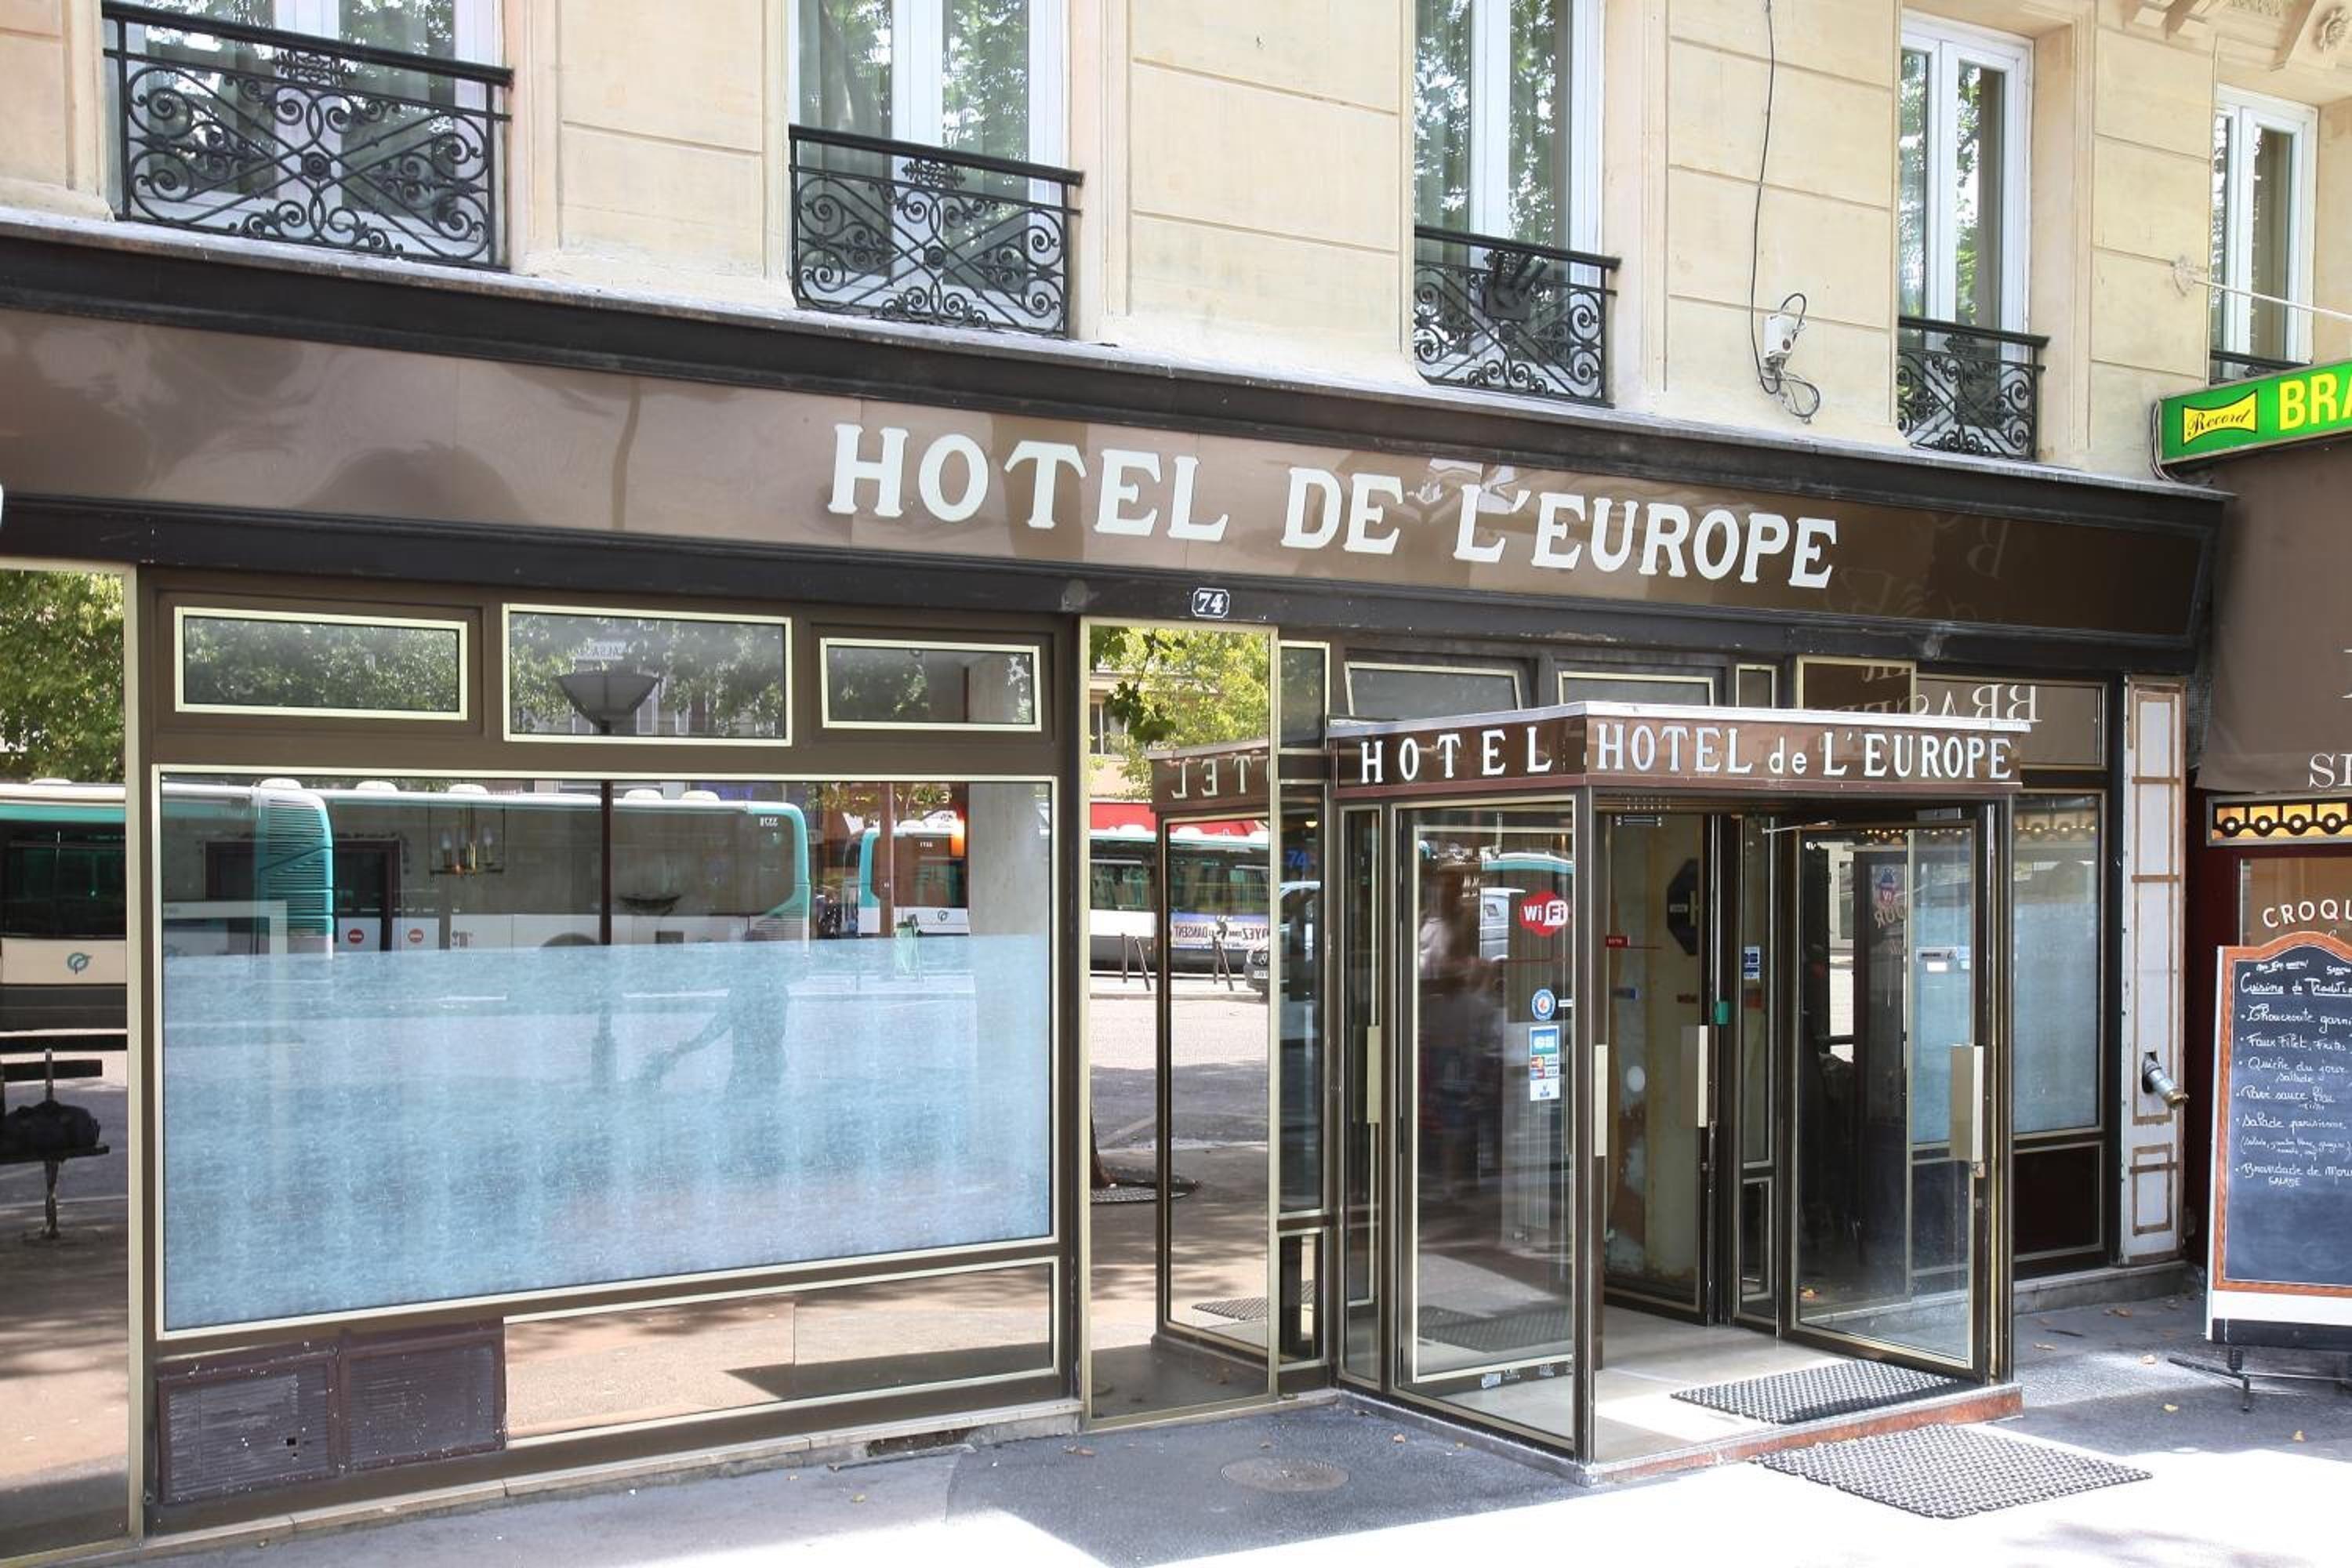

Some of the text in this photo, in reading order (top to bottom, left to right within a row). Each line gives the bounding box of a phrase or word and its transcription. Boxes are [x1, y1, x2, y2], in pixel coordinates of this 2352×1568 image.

[2187, 408, 2251, 437] Record
[827, 423, 1838, 590] HOTEL DE L'EUROPE
[1197, 592, 1224, 615] 74
[1360, 727, 1553, 784] HOTEL
[1597, 723, 2012, 779] HOTEL de L'EUROPE
[2241, 972, 2284, 993] Cuisine
[2292, 980, 2303, 992] de
[2248, 1056, 2290, 1071] Quiche
[2296, 1061, 2314, 1072] du
[2275, 1091, 2309, 1100] sauce
[2242, 1112, 2285, 1128] Salade
[2307, 1164, 2321, 1177] de
